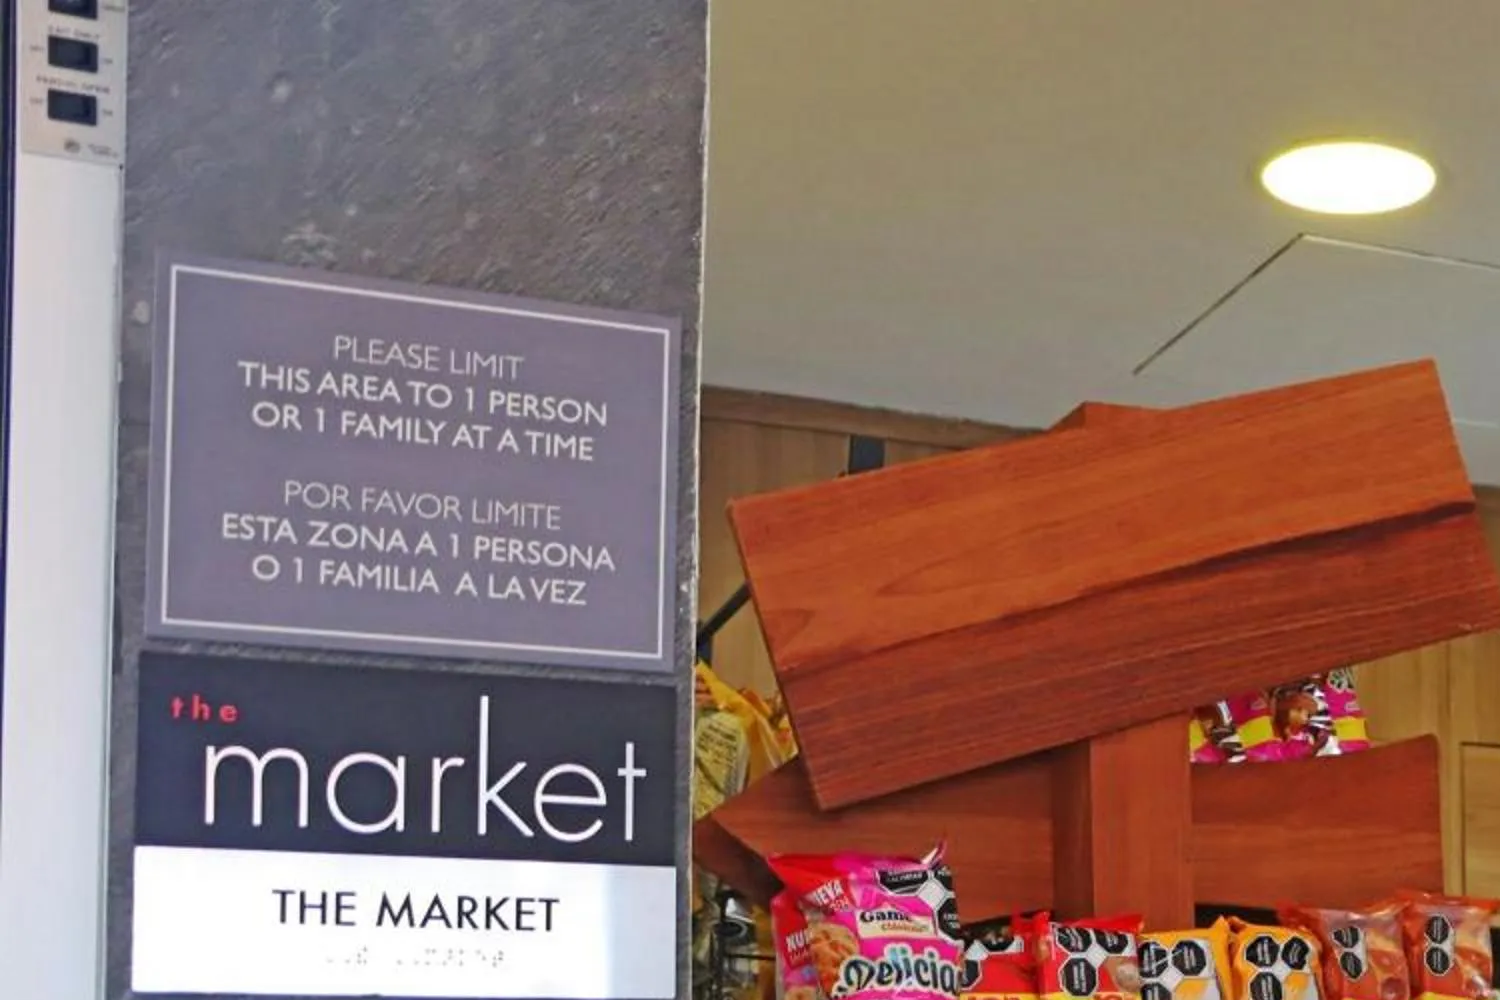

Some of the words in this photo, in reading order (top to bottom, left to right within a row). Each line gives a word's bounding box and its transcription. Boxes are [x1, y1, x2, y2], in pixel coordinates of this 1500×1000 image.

[333, 335, 440, 373] PLEASE
[449, 350, 525, 381] LIMIT
[237, 361, 311, 394] THIS
[316, 372, 401, 403] AREA
[407, 381, 452, 408] TO
[465, 387, 475, 413] 1
[489, 393, 608, 427] PERSON
[251, 401, 302, 431] OR
[315, 407, 325, 433] 1
[341, 411, 446, 445] FAMILY
[452, 424, 491, 450] AT
[497, 429, 520, 454] A
[524, 431, 594, 461] TIME
[284, 480, 351, 510] POR
[361, 487, 462, 522] FAVOR
[471, 499, 562, 530] LIMITE
[221, 513, 297, 545] ESTA
[306, 521, 408, 554] ZONA
[414, 534, 438, 556] A
[450, 533, 459, 558] 1
[474, 535, 616, 572] PERSONA
[252, 555, 281, 581] O
[293, 558, 303, 582] 1
[319, 560, 440, 594] FAMILIA
[454, 573, 478, 597] A
[488, 576, 526, 600] LA
[529, 578, 587, 605] VEZ
[169, 696, 239, 723] the
[204, 695, 648, 843] market
[272, 889, 357, 926] THE
[375, 891, 560, 932] MARKET
